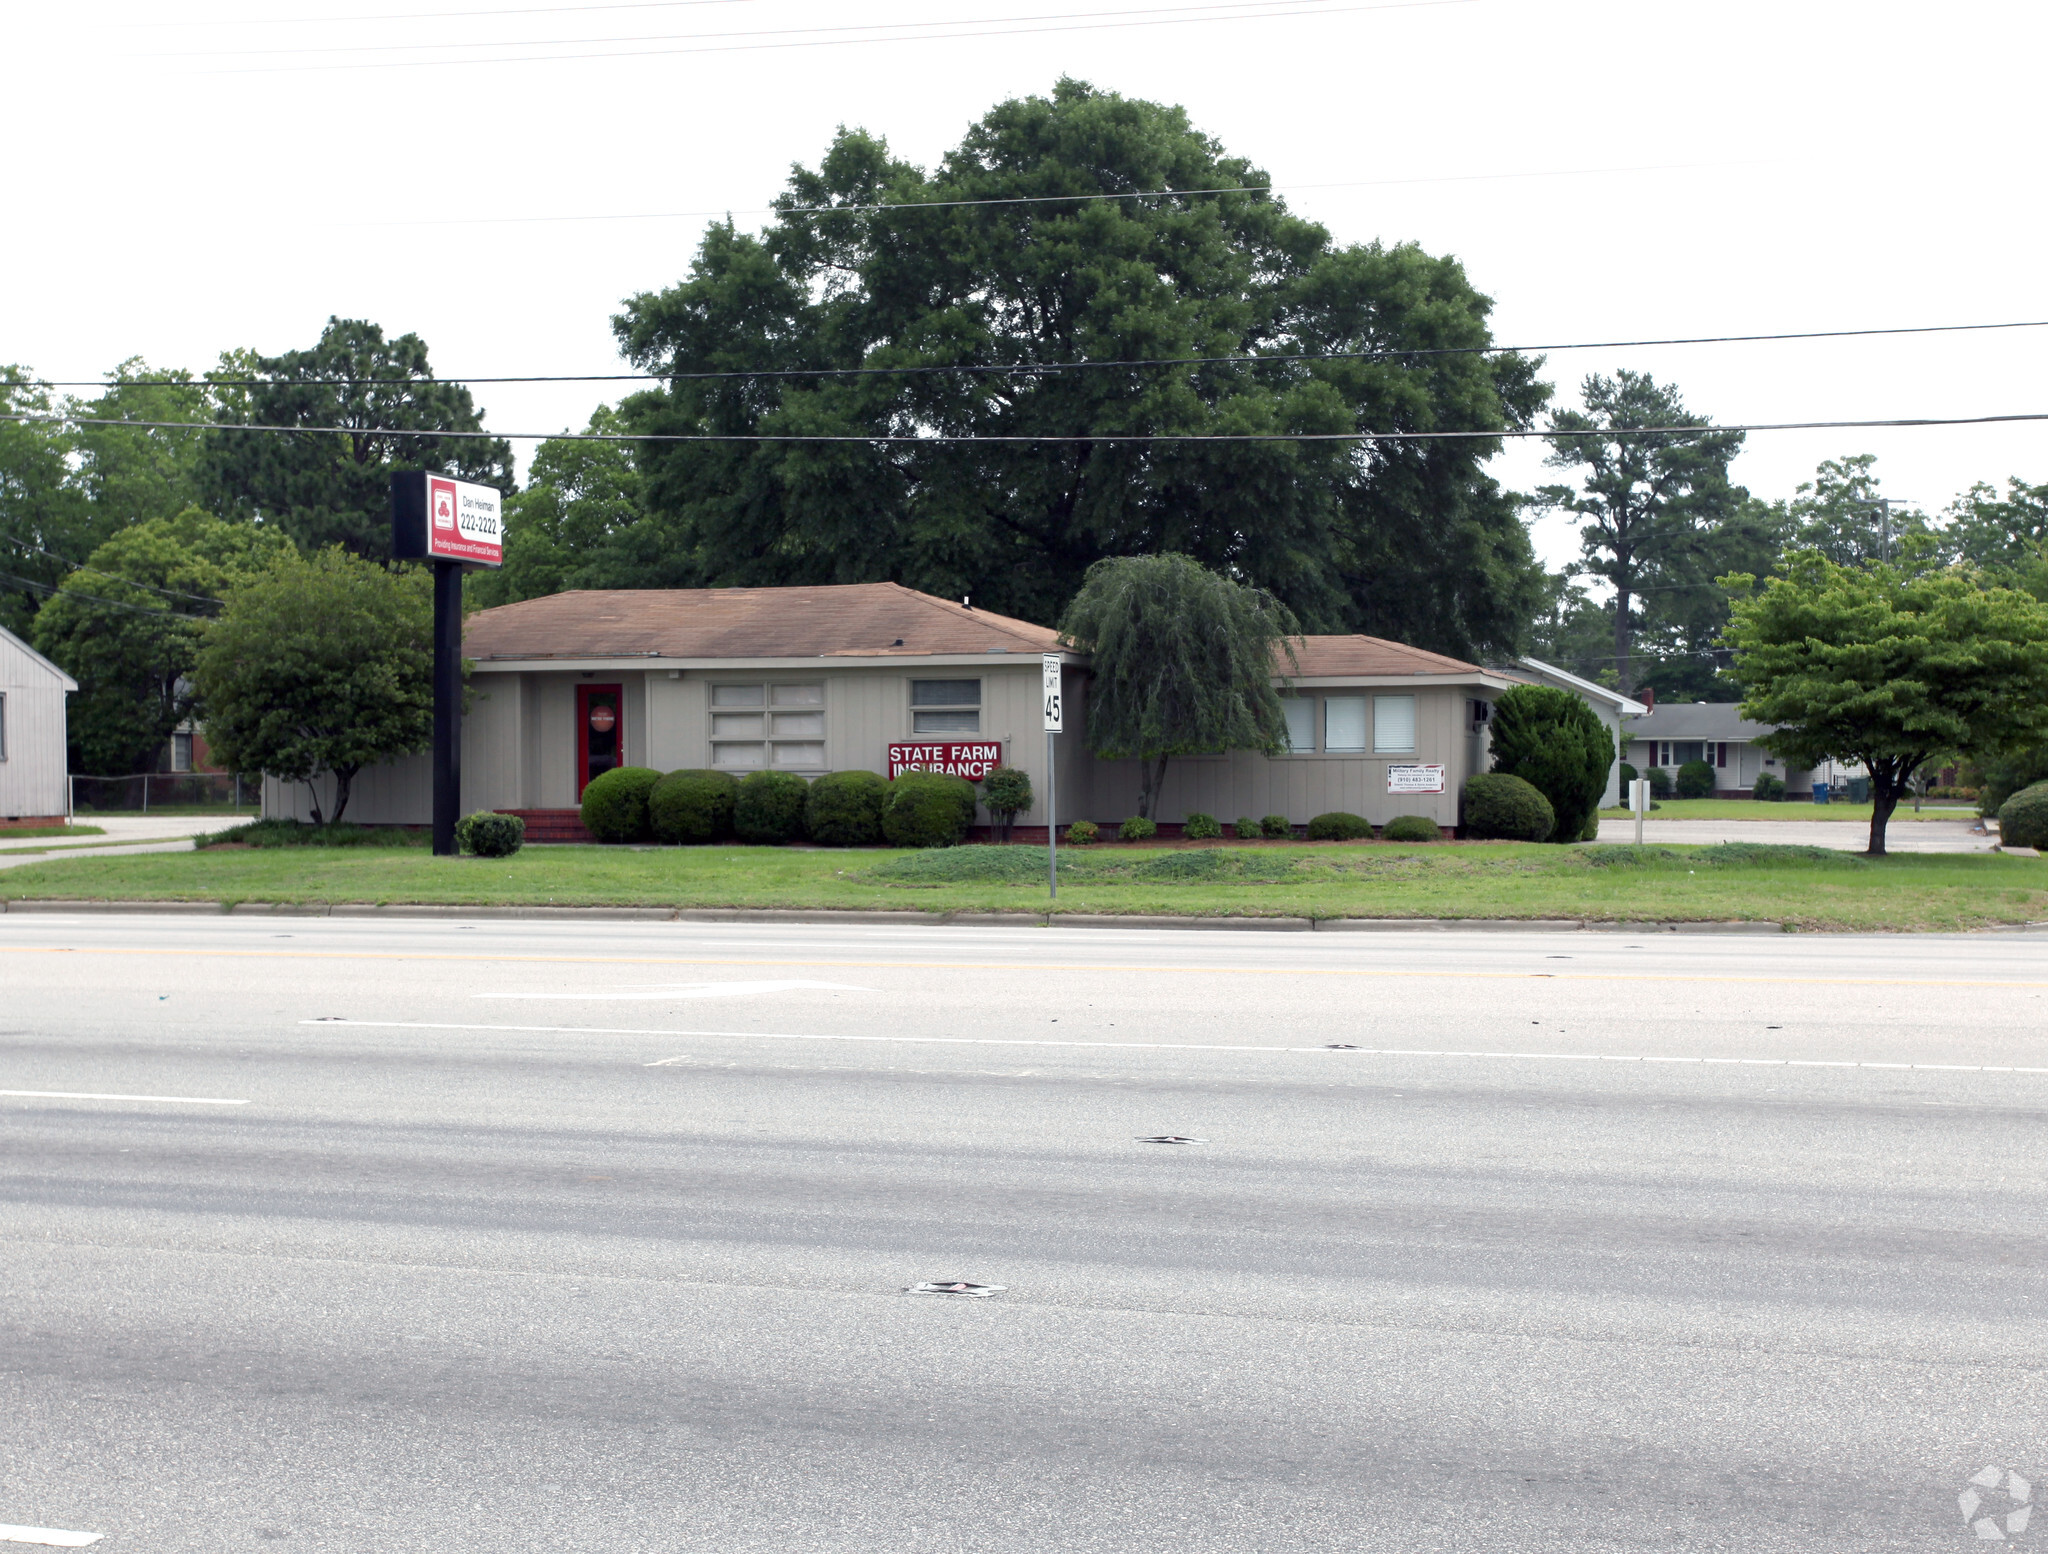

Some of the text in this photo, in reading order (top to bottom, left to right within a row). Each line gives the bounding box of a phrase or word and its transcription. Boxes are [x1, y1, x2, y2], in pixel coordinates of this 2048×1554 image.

[463, 496, 474, 508] Dan
[461, 513, 496, 534] 222-2222
[435, 538, 450, 551] Providing
[451, 541, 467, 552] Insurance
[473, 544, 487, 555] Financial
[487, 546, 499, 556] Services
[1044, 660, 1059, 673] SPEED
[1045, 677, 1058, 688] LIMIT
[1046, 695, 1060, 722] 45
[890, 746, 996, 761] STATE FARM
